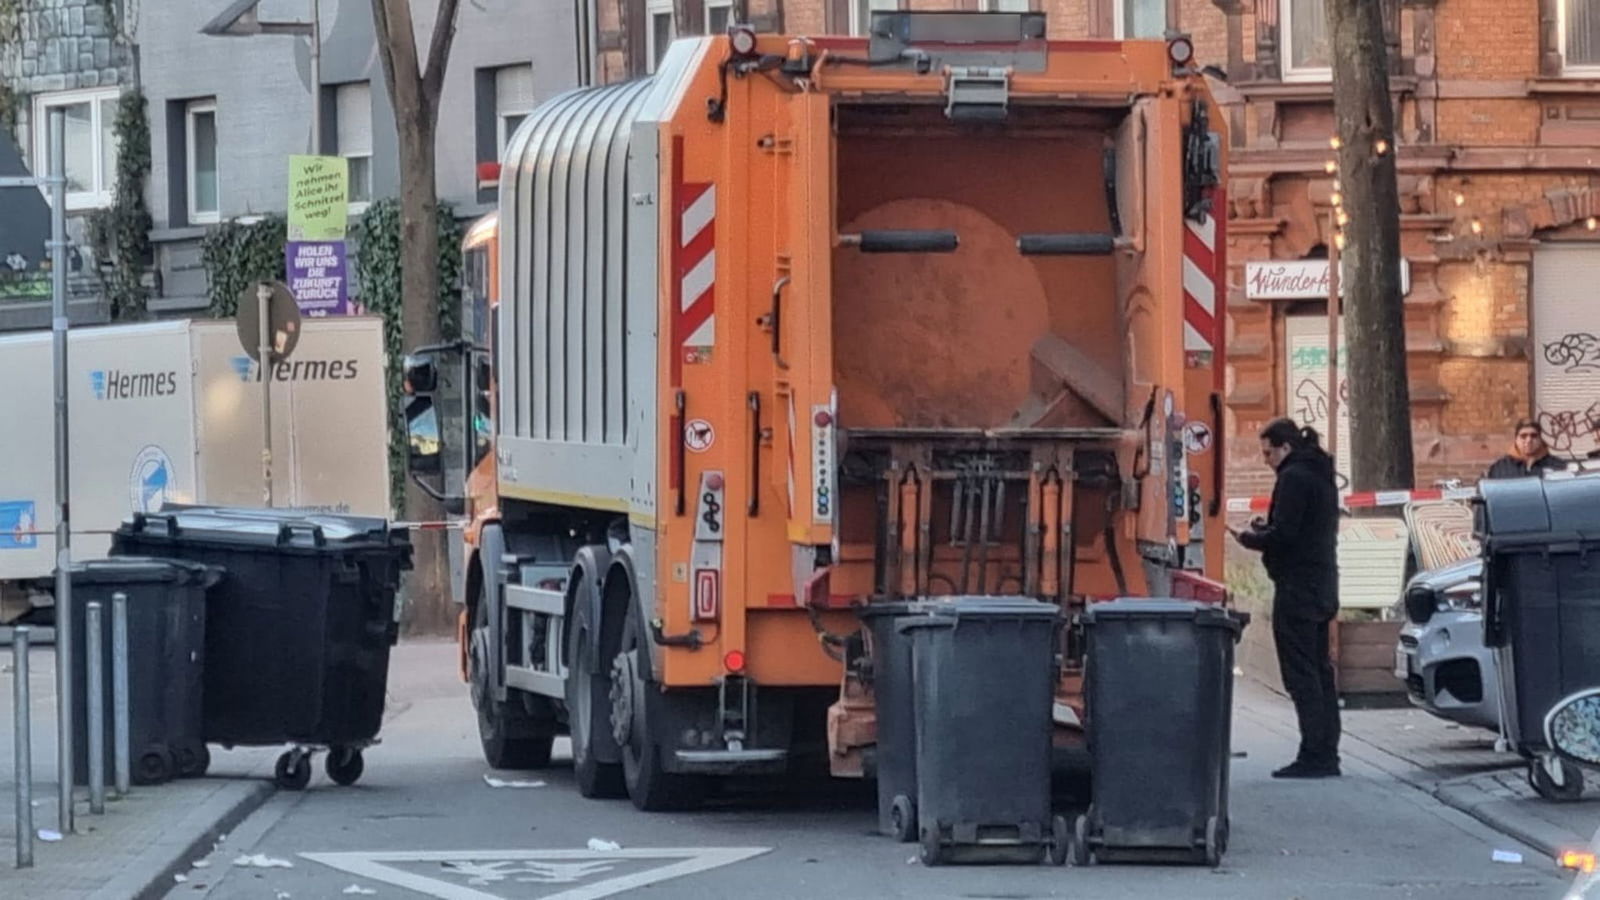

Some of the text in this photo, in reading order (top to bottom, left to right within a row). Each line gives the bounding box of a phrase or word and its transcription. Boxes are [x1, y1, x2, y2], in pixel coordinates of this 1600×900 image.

[303, 163, 323, 174] Wir
[296, 172, 341, 187] nehmen
[296, 183, 338, 199] Alice ihr
[294, 192, 344, 210] Schnitzel
[304, 206, 332, 219] weg!
[298, 245, 334, 257] HOLEN
[294, 255, 338, 269] WIR UNS
[307, 267, 326, 278] DIE
[292, 276, 342, 290] ZUKUNFT
[1249, 265, 1344, 295] Wunderk
[106, 370, 177, 400] Hermes
